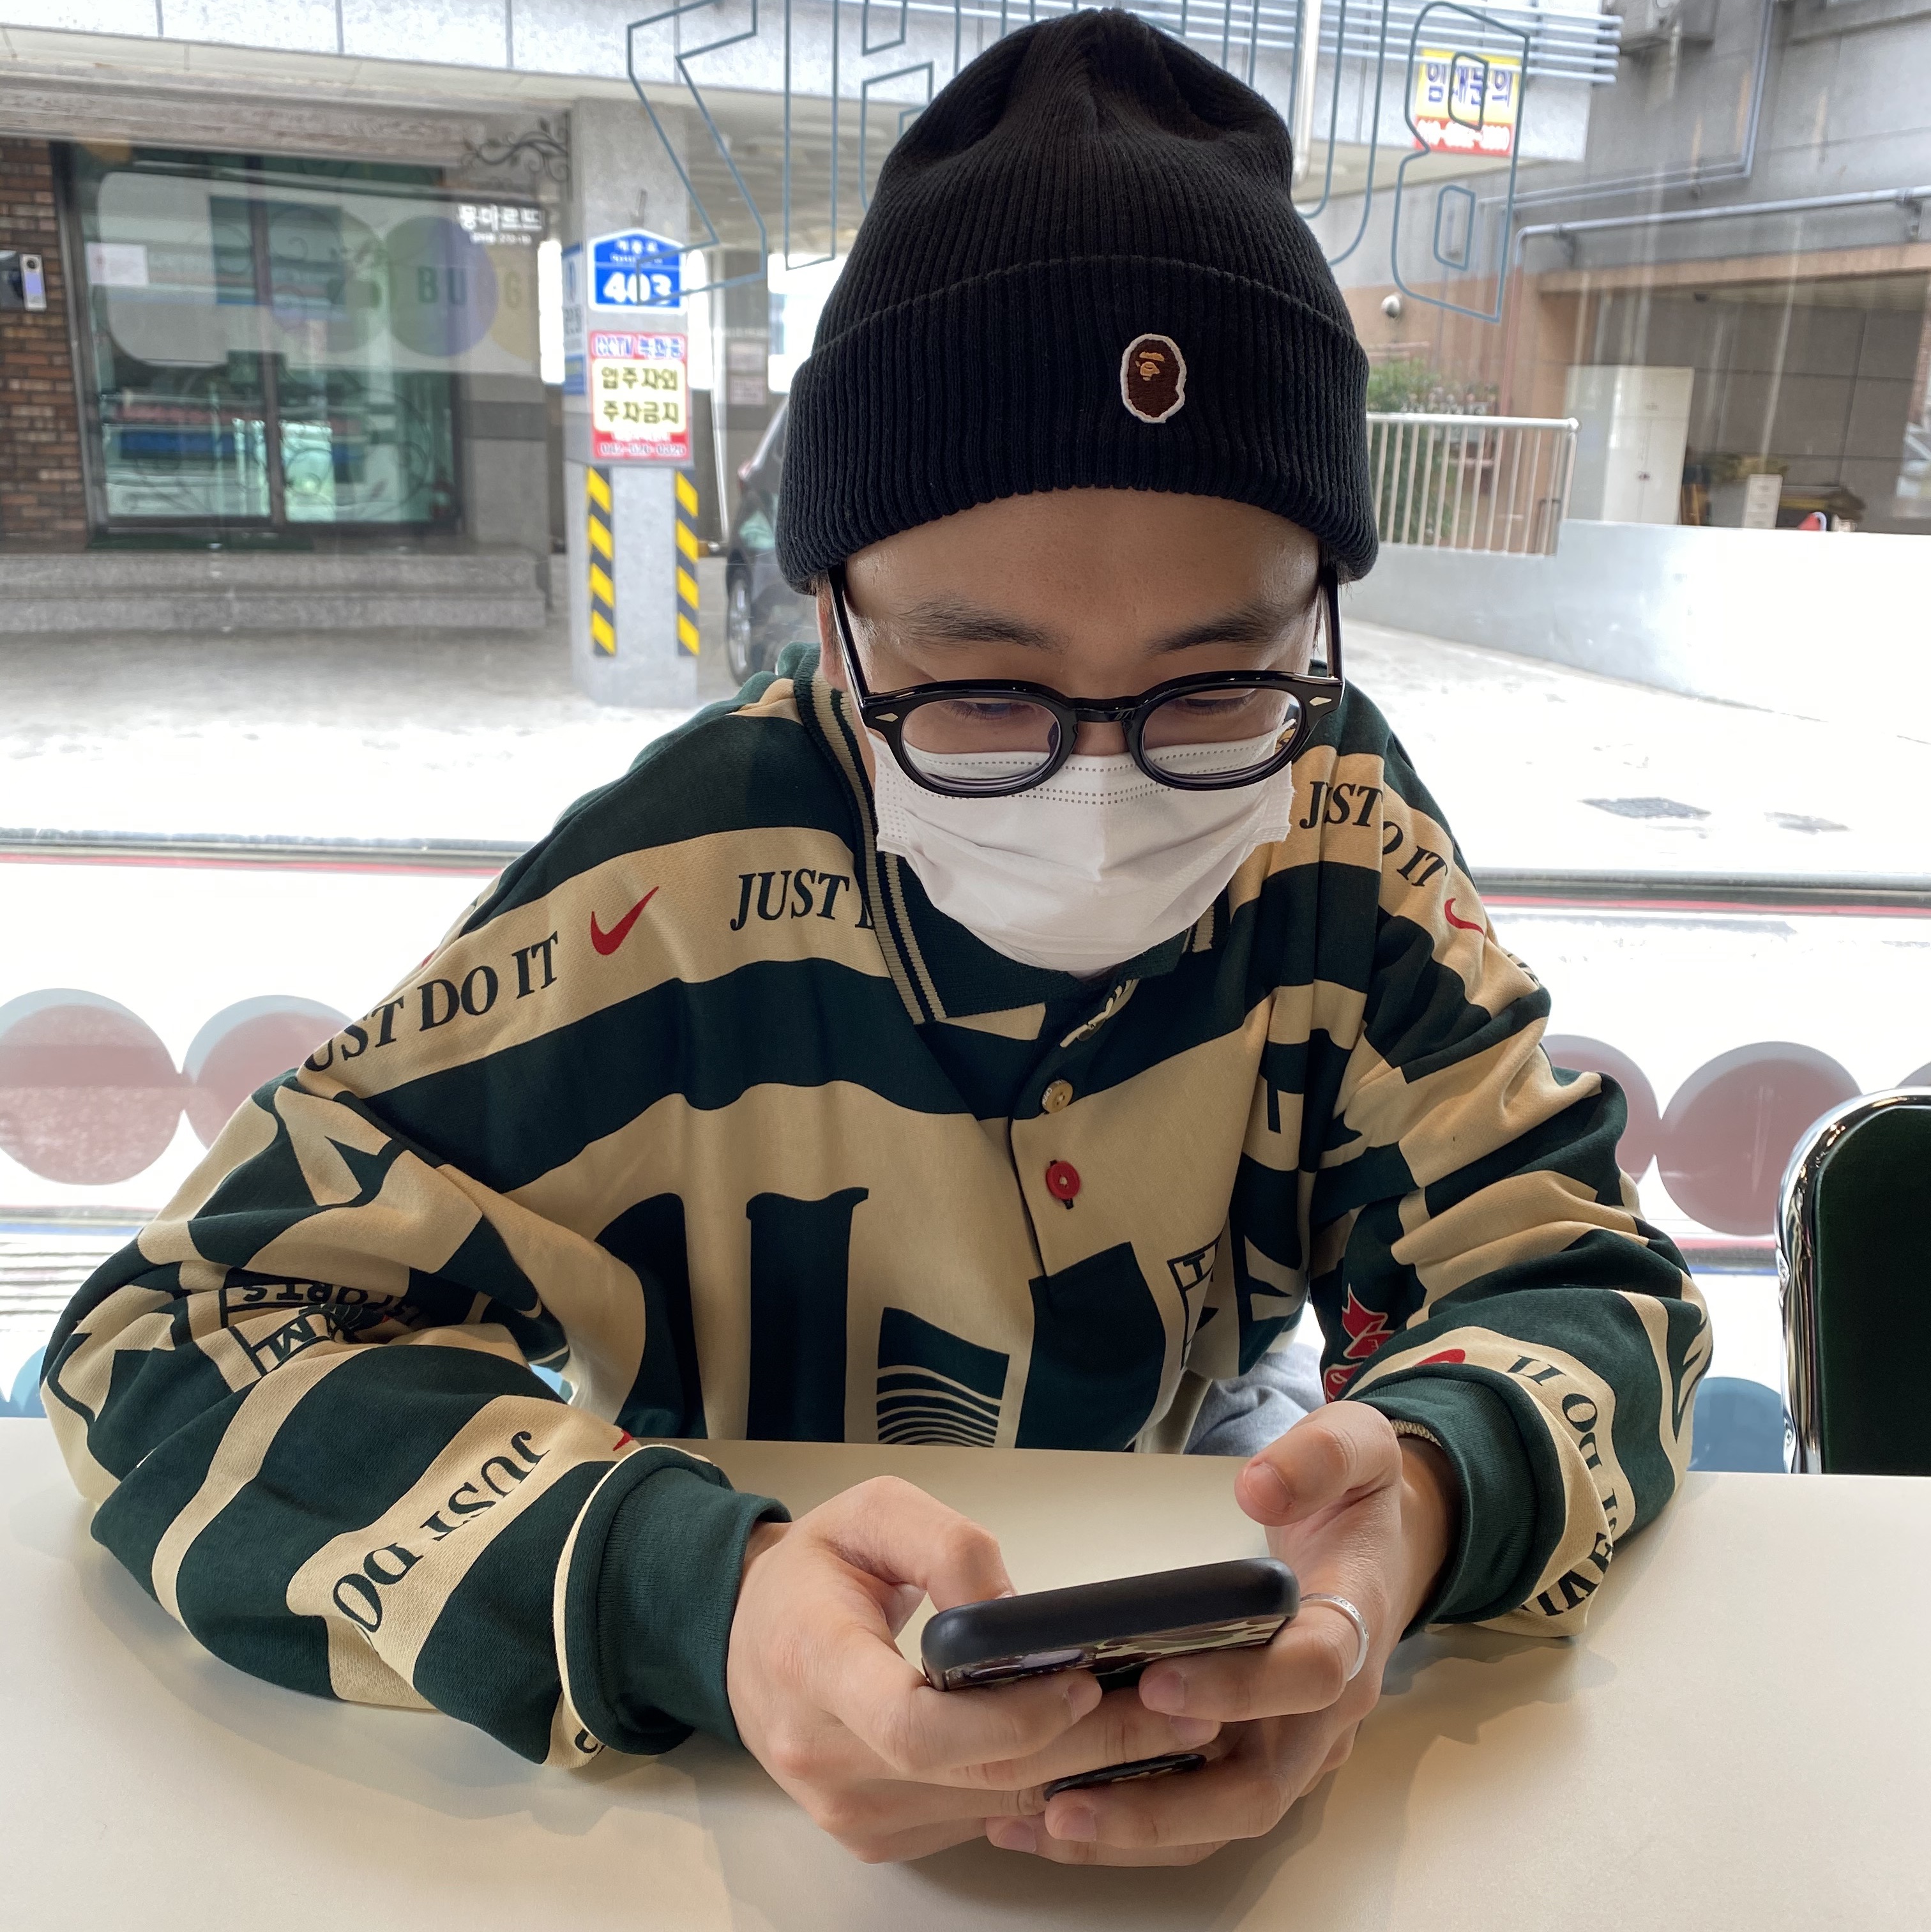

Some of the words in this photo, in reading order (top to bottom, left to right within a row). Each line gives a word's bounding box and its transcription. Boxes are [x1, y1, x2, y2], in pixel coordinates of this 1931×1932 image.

[604, 272, 672, 306] 403
[1299, 780, 1383, 829] JST
[1396, 845, 1448, 887] IT
[730, 868, 850, 931] JUST
[305, 996, 404, 1071] UST
[418, 965, 499, 1031] DO
[512, 931, 558, 999] IT
[420, 1430, 550, 1541] JUST
[332, 1542, 424, 1633] DO
